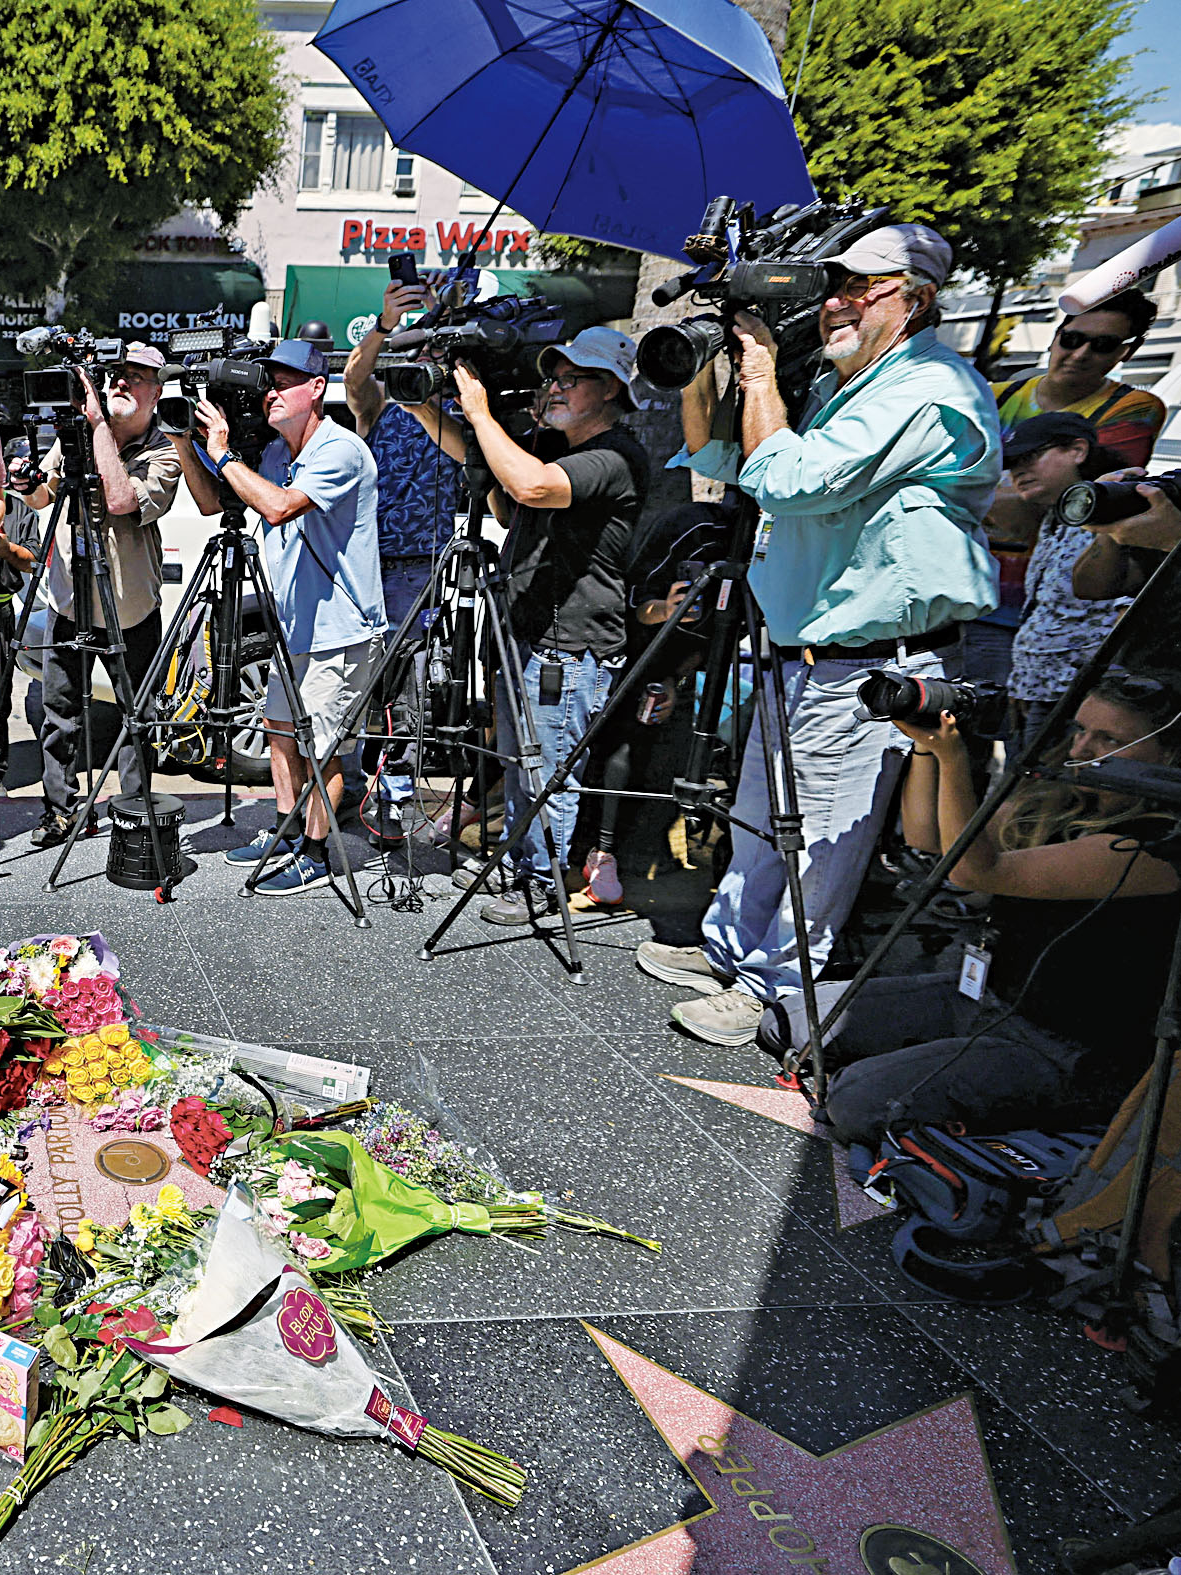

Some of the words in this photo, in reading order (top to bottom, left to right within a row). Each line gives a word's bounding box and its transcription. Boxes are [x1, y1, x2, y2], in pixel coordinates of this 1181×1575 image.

[342, 220, 426, 250] Pizza
[436, 221, 530, 252] Worx
[119, 312, 180, 329] ROCK
[150, 331, 169, 342] 323
